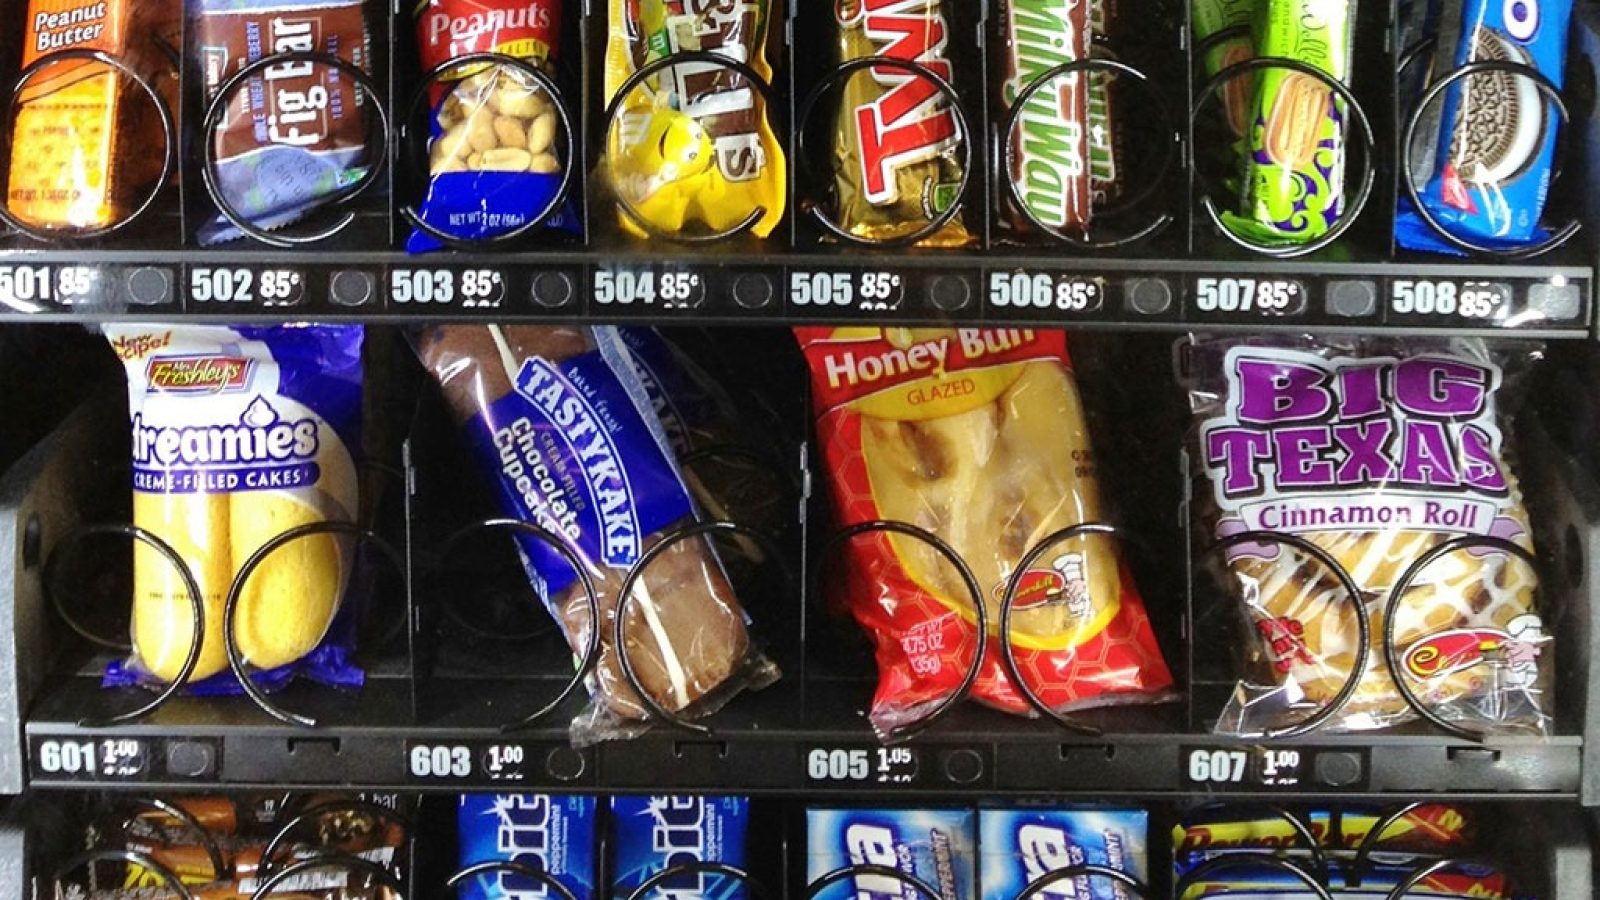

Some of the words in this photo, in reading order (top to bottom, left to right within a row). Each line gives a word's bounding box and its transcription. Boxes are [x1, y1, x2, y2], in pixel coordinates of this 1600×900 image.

[35, 2, 106, 32] Peanut
[430, 3, 551, 46] Peanuts
[36, 22, 104, 51] Butter
[264, 17, 314, 80] Bar
[268, 85, 328, 145] Fig
[0, 265, 50, 300] 501
[192, 269, 252, 301] 502
[391, 270, 453, 303] 503
[594, 271, 655, 303] 504
[791, 272, 853, 305] 505
[990, 274, 1053, 307] 506
[1197, 279, 1255, 312] 507
[1393, 281, 1456, 314] 508
[152, 360, 240, 391] Freshley's
[823, 338, 948, 389] Honey
[906, 379, 976, 406] GLAZED
[1235, 355, 1490, 423] BIG
[523, 361, 635, 559] TASTYKAKE
[1206, 419, 1510, 498] TEXAS
[510, 416, 581, 540] Chocolate
[1258, 504, 1412, 529] Cinnamon
[1423, 503, 1479, 528] Roll
[41, 741, 96, 772] 601
[103, 739, 138, 764] 1.00
[410, 746, 471, 777] 603
[488, 746, 523, 772] 1.00
[808, 749, 869, 779] 605
[877, 747, 912, 773] 1.05
[1188, 749, 1246, 782] 607
[1262, 749, 1299, 776] 1.00
[498, 794, 550, 900] bit
[550, 804, 562, 875] peppermint
[652, 795, 704, 900] bit
[705, 804, 716, 862] ppermint
